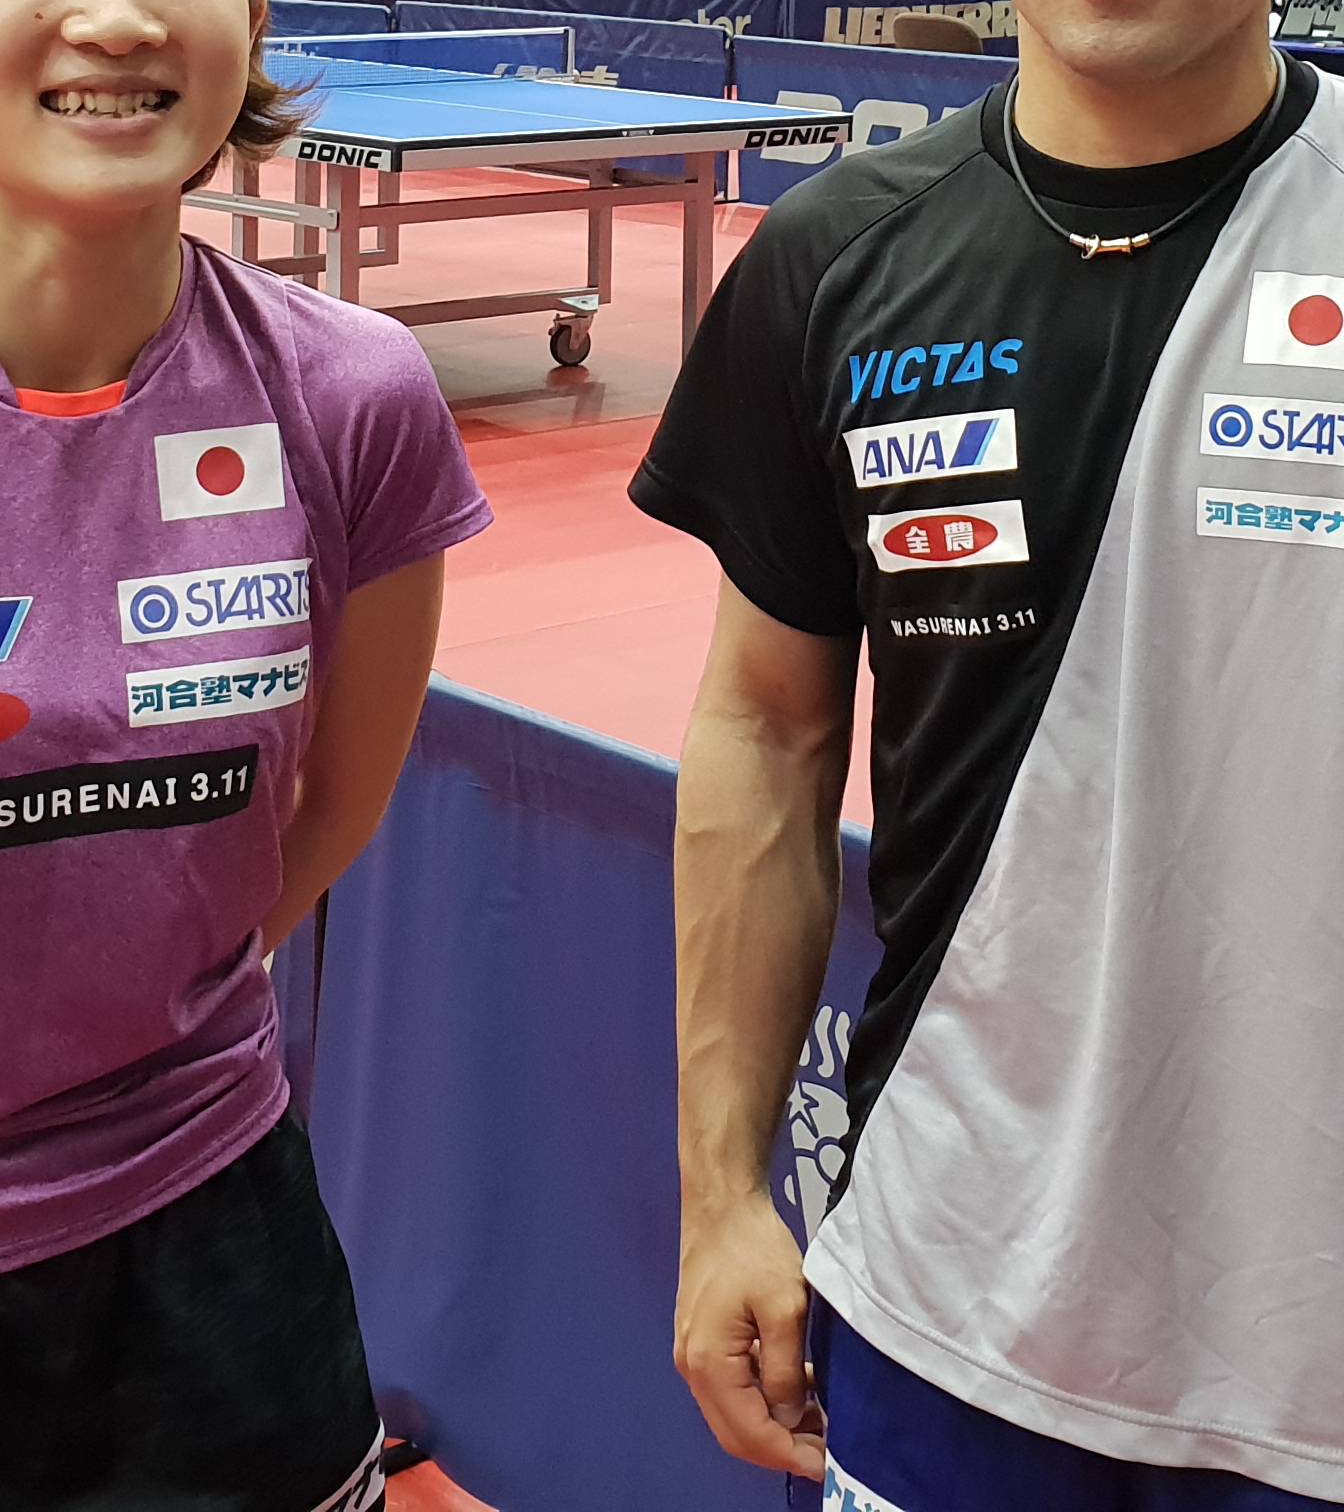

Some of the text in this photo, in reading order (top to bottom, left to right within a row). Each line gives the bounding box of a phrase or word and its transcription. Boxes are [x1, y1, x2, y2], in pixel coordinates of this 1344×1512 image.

[298, 141, 383, 169] DONIC
[744, 125, 840, 150] DONIC
[848, 337, 1023, 404] VICTAS
[862, 430, 946, 481] ANA
[903, 520, 975, 556] 全農
[891, 608, 1037, 640] WASURENAI 3.11
[130, 663, 309, 716] 河合塾マナビス
[190, 764, 250, 803] 3.11
